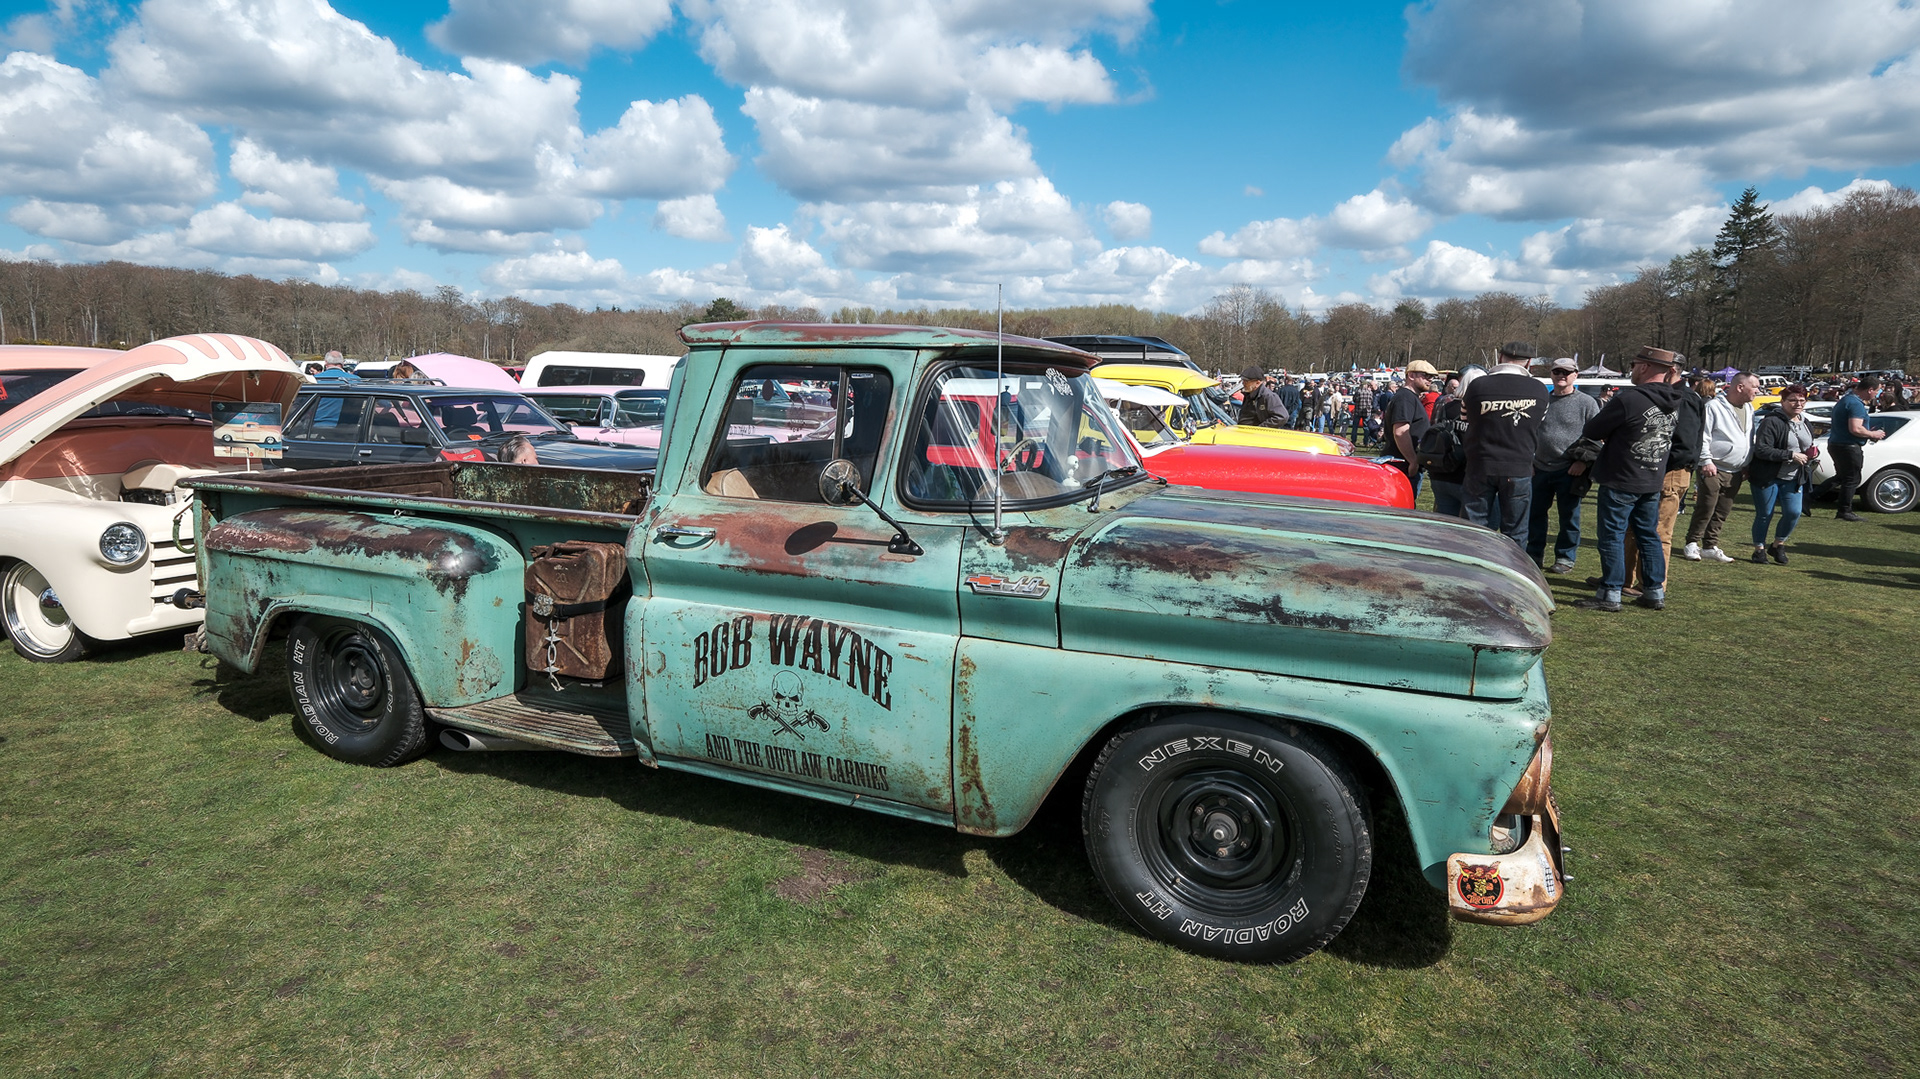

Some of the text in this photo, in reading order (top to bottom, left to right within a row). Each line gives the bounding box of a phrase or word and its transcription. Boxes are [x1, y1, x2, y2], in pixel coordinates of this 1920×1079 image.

[1480, 398, 1537, 415] DETONATORS
[693, 613, 894, 712] BOB WAYNE
[293, 639, 340, 744] ROADIAN HT
[704, 733, 890, 792] AND THE OUTLAW CARNIES
[1138, 736, 1285, 773] NEXEN
[1136, 891, 1311, 945] ROADIAN HT
